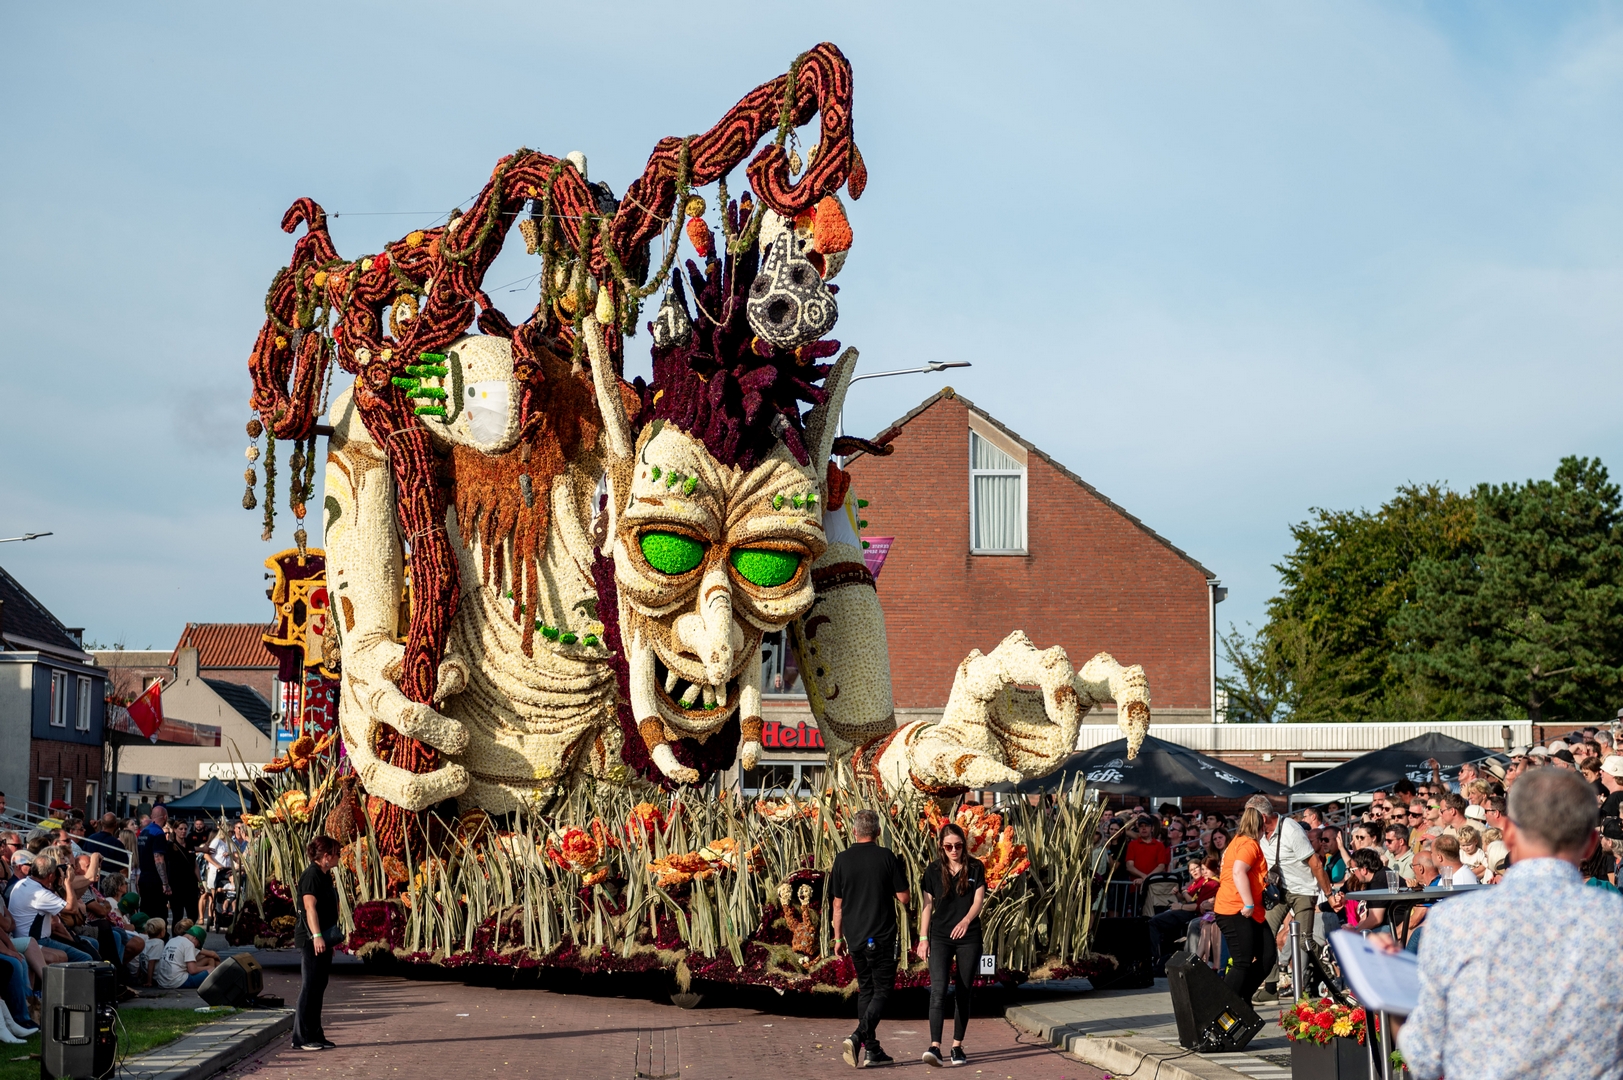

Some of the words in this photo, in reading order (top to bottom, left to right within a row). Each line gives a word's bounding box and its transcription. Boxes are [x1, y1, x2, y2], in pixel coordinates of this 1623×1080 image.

[762, 721, 825, 747] Hein
[1086, 768, 1125, 783] Leffe
[982, 957, 993, 968] 18
